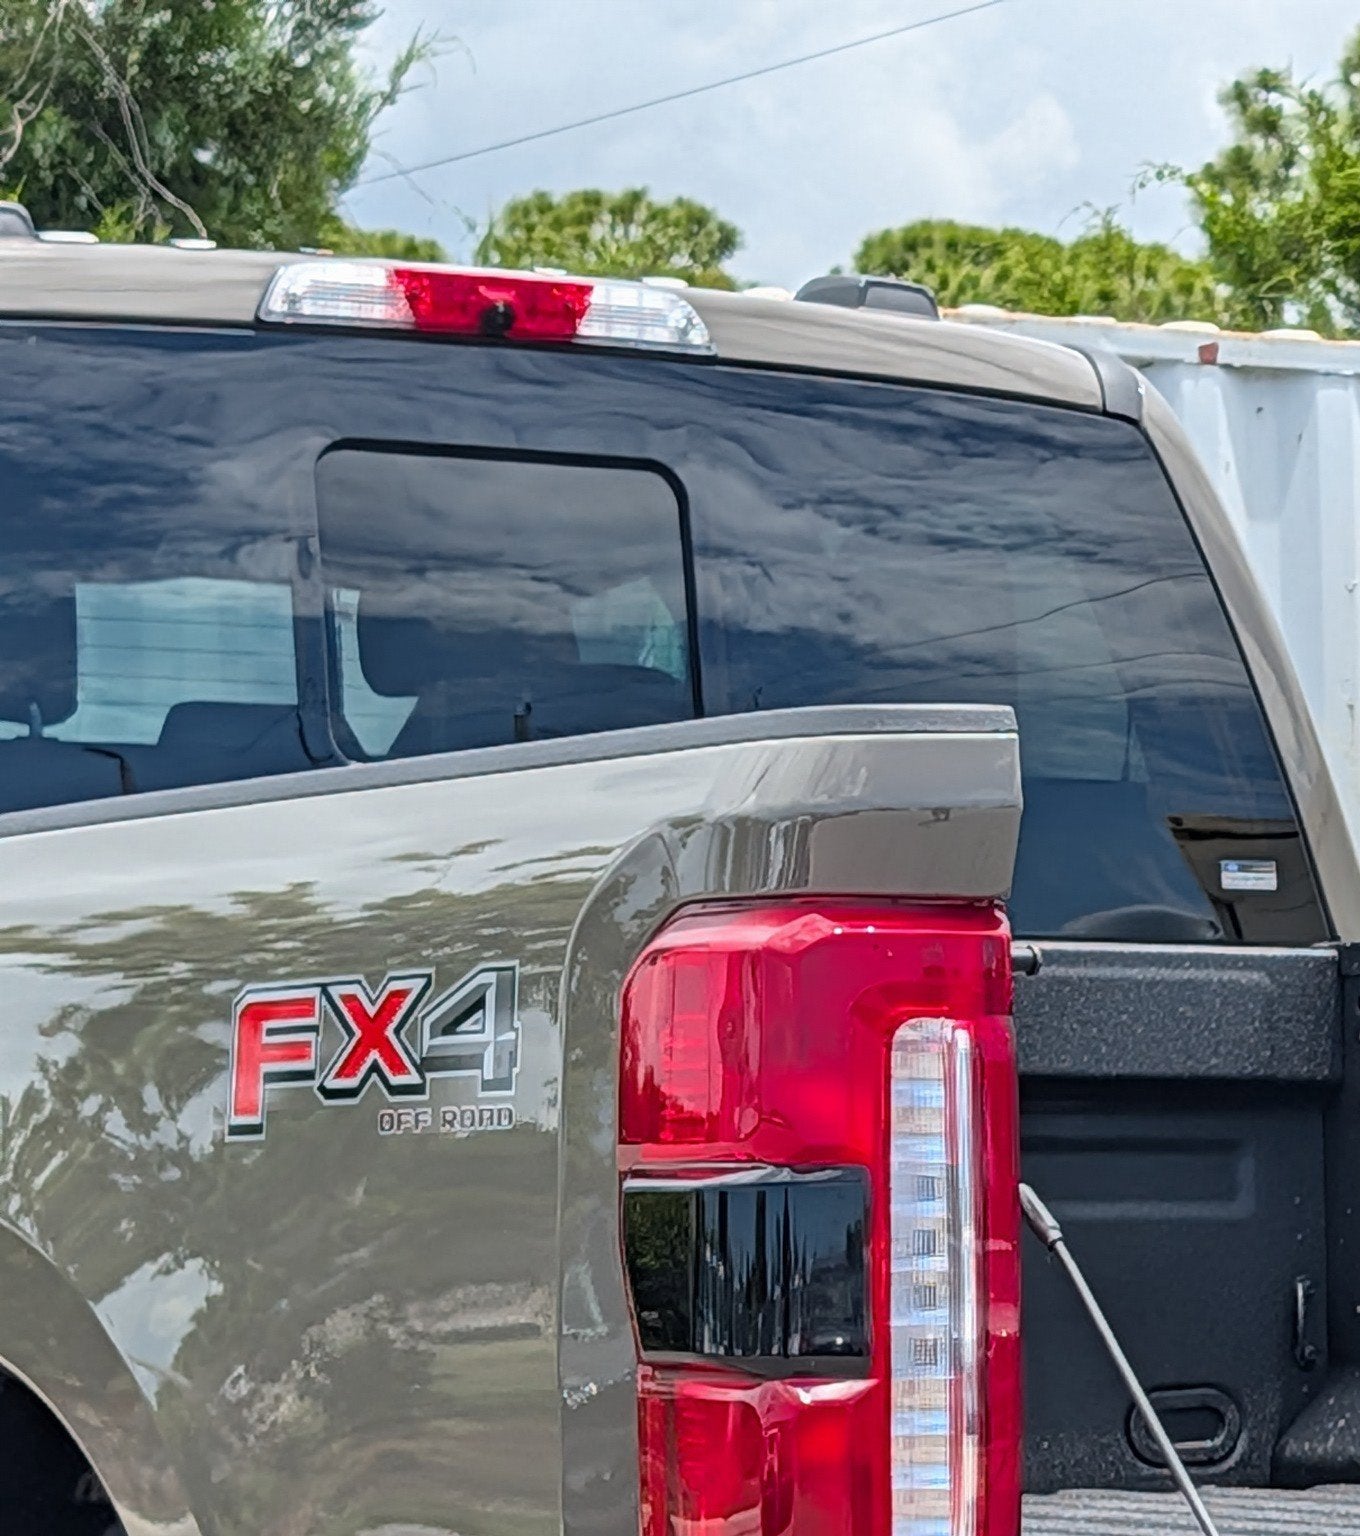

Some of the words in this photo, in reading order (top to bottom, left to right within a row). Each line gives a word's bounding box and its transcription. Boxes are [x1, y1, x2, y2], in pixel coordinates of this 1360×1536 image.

[226, 960, 522, 1142] FX4
[378, 1107, 431, 1136] OFF
[441, 1105, 515, 1133] ROAD
